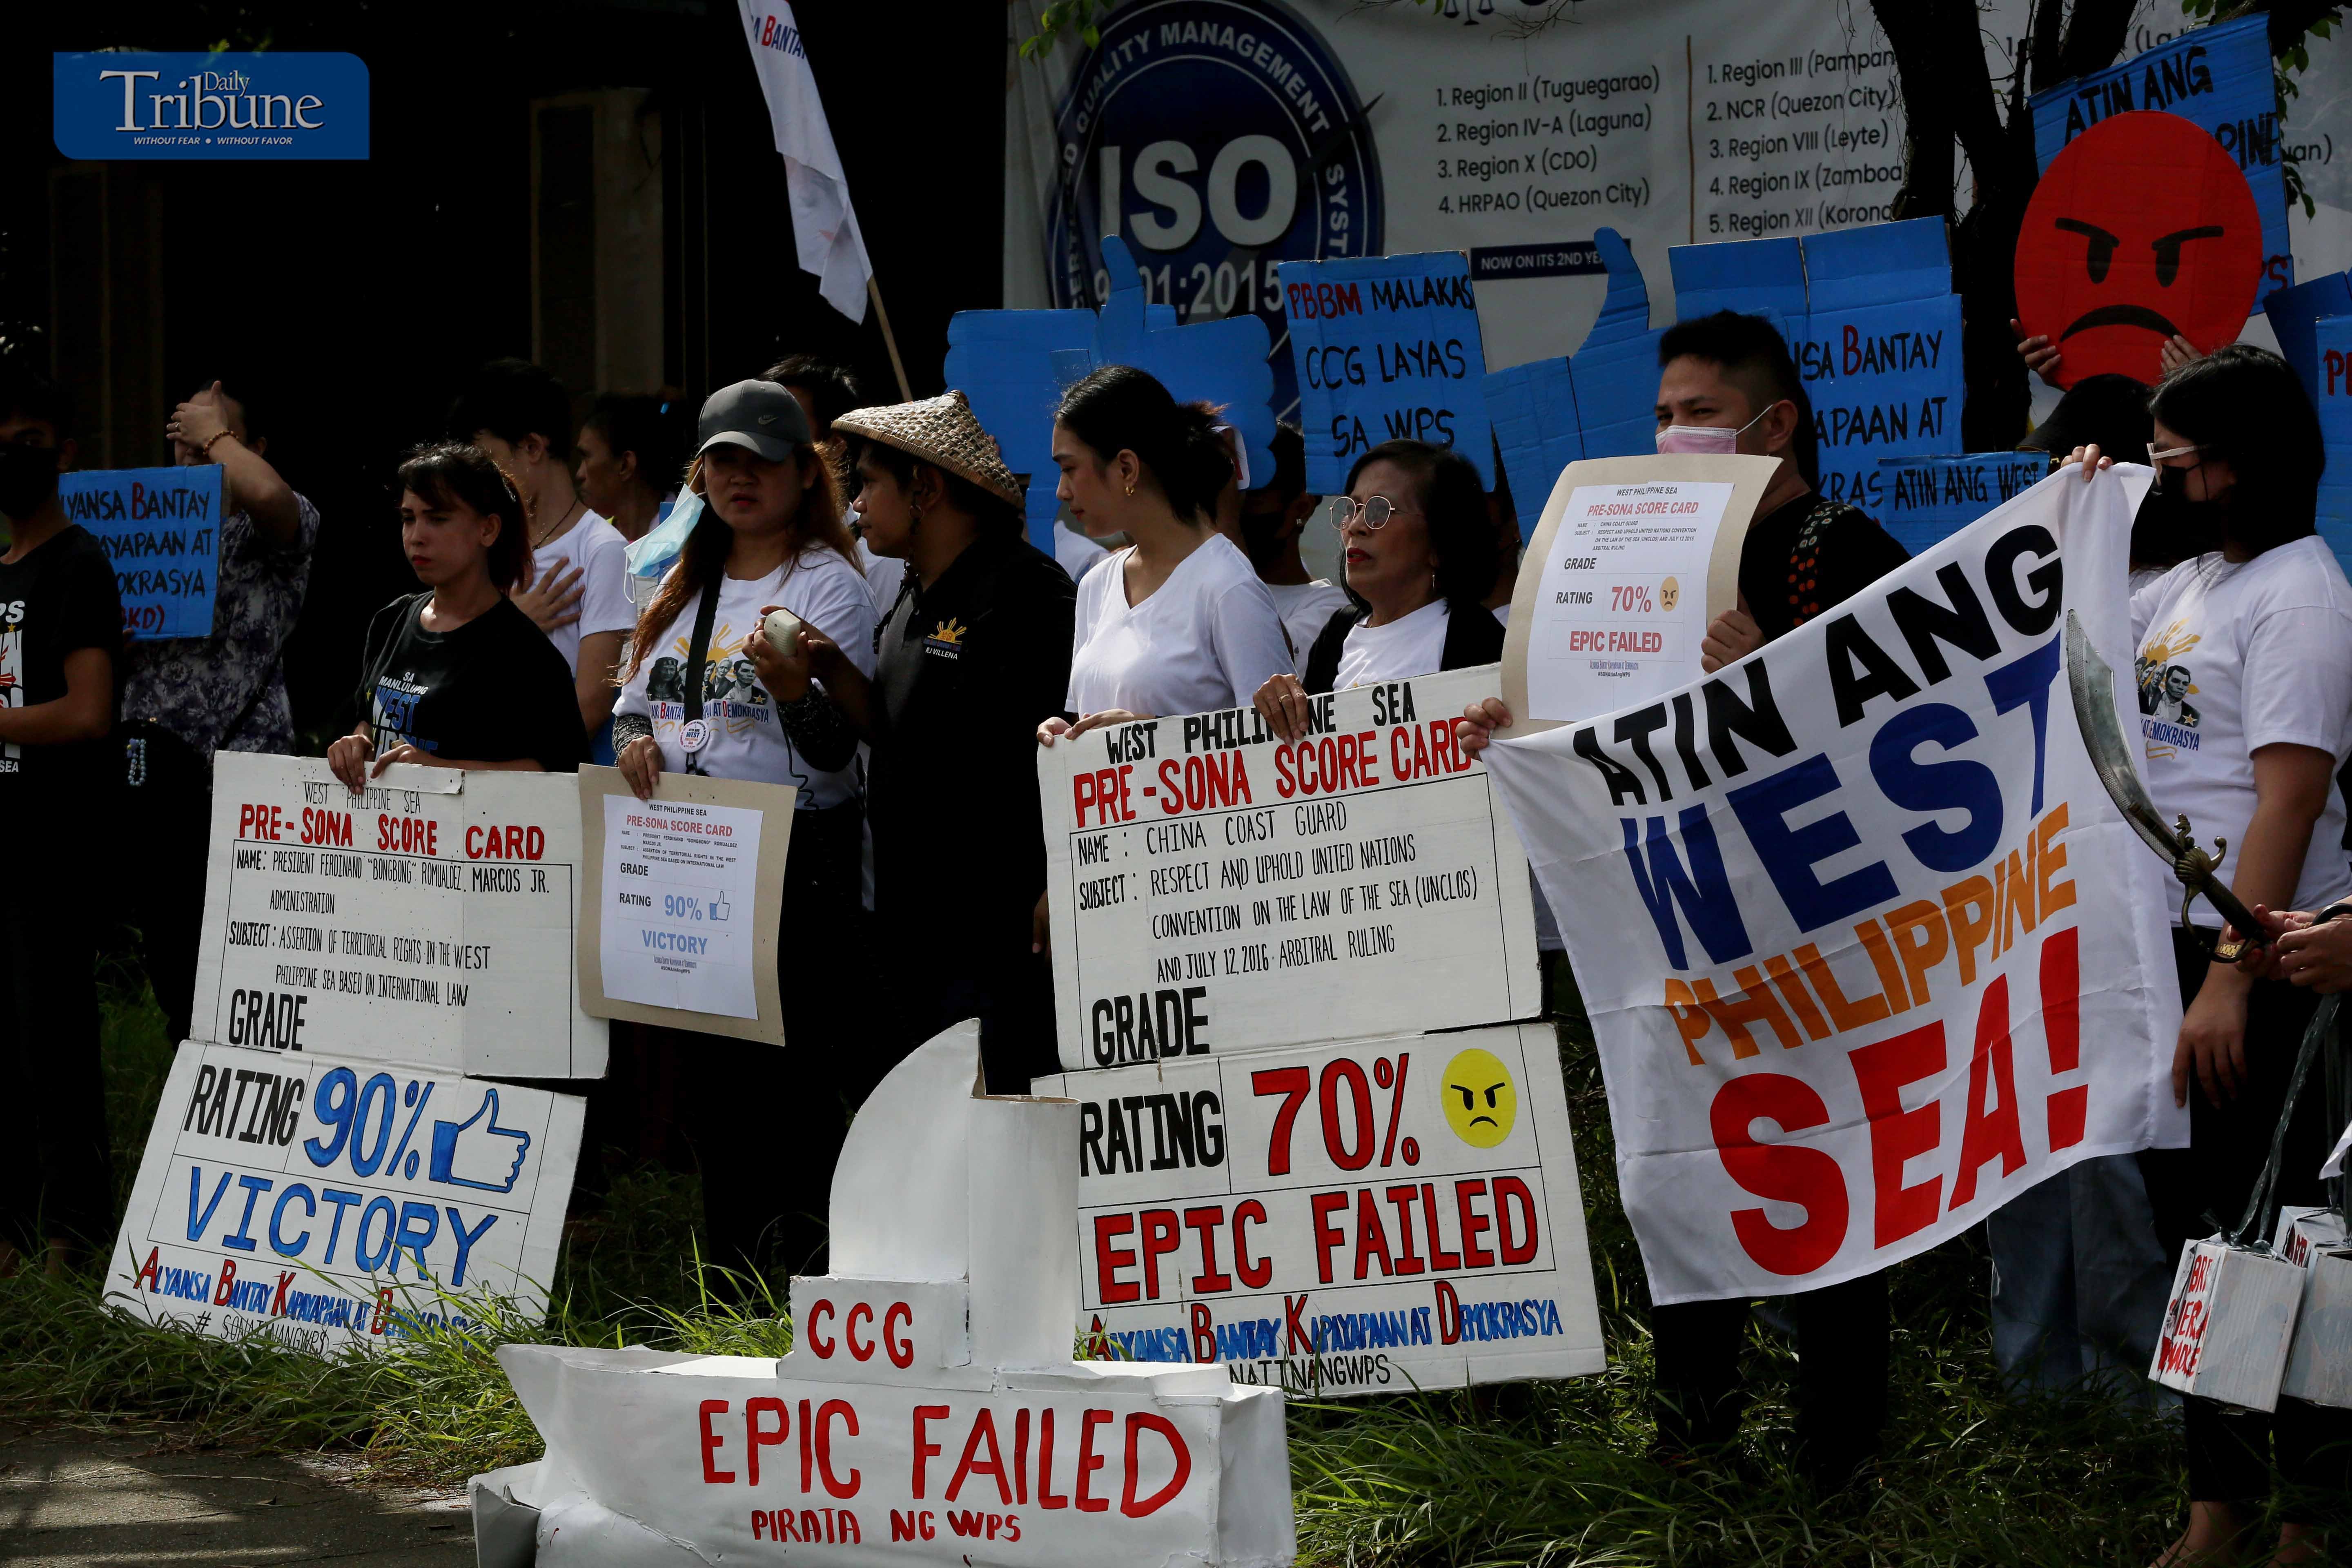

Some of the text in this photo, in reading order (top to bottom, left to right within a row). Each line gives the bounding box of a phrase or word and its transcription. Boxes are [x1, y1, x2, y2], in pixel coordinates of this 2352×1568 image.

[1076, 20, 1330, 134] QUALITY MANAGEMENT
[1452, 65, 1660, 110] Region II (Tuguegarao)
[2144, 46, 2214, 111] ANG
[1727, 80, 1896, 120] NCR (Quezon City)
[1457, 103, 1652, 145] Region IV-A (Laguna)
[1729, 119, 1888, 161] Region VIII (Leyte)
[1457, 145, 1597, 181] Region X (CDO)
[1099, 134, 1297, 251] ISO
[1459, 177, 1649, 213] HRPAO (Quezon City)
[1481, 250, 1582, 271] NOW ON ITS 2ND
[1287, 274, 1474, 319] PBBM MALAKAS
[1306, 339, 1465, 390] CCG LAYAS
[1843, 325, 1942, 376] BANTAY
[1331, 408, 1454, 457] SA WPS
[132, 483, 210, 520] BANTAY
[1587, 502, 1699, 517] PRE-SONA SCORE CARD
[1634, 487, 1664, 495] PHILIPPINE
[1895, 470, 1937, 511] ATIN
[1944, 466, 1987, 505] ANG
[1564, 557, 1597, 570] GRADE
[1556, 586, 1652, 612] RATING 70%
[933, 648, 958, 660] VILLENA
[1570, 631, 1662, 653] EPIC FAILED
[379, 676, 429, 695] MANLULUPIG
[403, 672, 415, 683] SA
[1572, 524, 2063, 807] ATIN ANG
[372, 686, 421, 733] WEST
[722, 701, 769, 723] DEMOKRASYA
[1106, 682, 1416, 764] WEST SEA
[1275, 731, 1379, 798] SCORE
[305, 783, 421, 814] WEST SEA
[649, 804, 663, 812] WEST
[664, 806, 694, 815] PHILIPPINE
[1620, 631, 2060, 971] WEST
[378, 814, 437, 855] SCORE
[466, 825, 544, 860] CARD
[627, 815, 732, 837] PRE-SONA SCORE CARD
[1147, 801, 1346, 854] CHINA COAST GUARD
[273, 851, 314, 874] PRESIDENT
[321, 854, 362, 879] FERDINAND
[422, 862, 461, 891] ROMUALDEZ
[473, 867, 520, 893] MARCOS
[530, 869, 550, 893] JR.
[620, 862, 648, 876] GRADE
[1151, 834, 1416, 896] RESPECT AND UPHOLD UNITED NATIONS
[270, 890, 334, 914] ADMINISTRATION
[619, 893, 702, 920] RATING 90%
[1153, 866, 1477, 939] CONVENTION ON THE LAW OF THE SEA (UNCLOS)
[279, 926, 490, 969] ASSERTION TERRITORIAL RIGHTS THE WEST
[642, 930, 708, 954] VICTORY
[1158, 924, 1394, 983] AND JULY 12, 2016 ARBITRAL RULING
[1664, 801, 2077, 1066] PHILIPPINE
[276, 965, 469, 1007] PHILIPPINE SEA BASED ON INTERNATIONAL LAW
[229, 989, 307, 1051] GRADE
[1092, 986, 1210, 1066] GRADE
[184, 1064, 435, 1180] RATING 90%
[1080, 1052, 1420, 1177] RATING 70%
[1710, 926, 2088, 1276] SEA!
[187, 1166, 499, 1287] VICTORY
[1094, 1176, 1539, 1305] EPIC FAILED
[133, 1246, 274, 1314] ALYANSA BANTAY
[807, 1299, 914, 1369] CCG
[1191, 1281, 1564, 1363] BANTAY DEMOKRASYA
[699, 1397, 1192, 1519] EPIC FAILED
[751, 1508, 1021, 1544] PIRATA NG WPS
